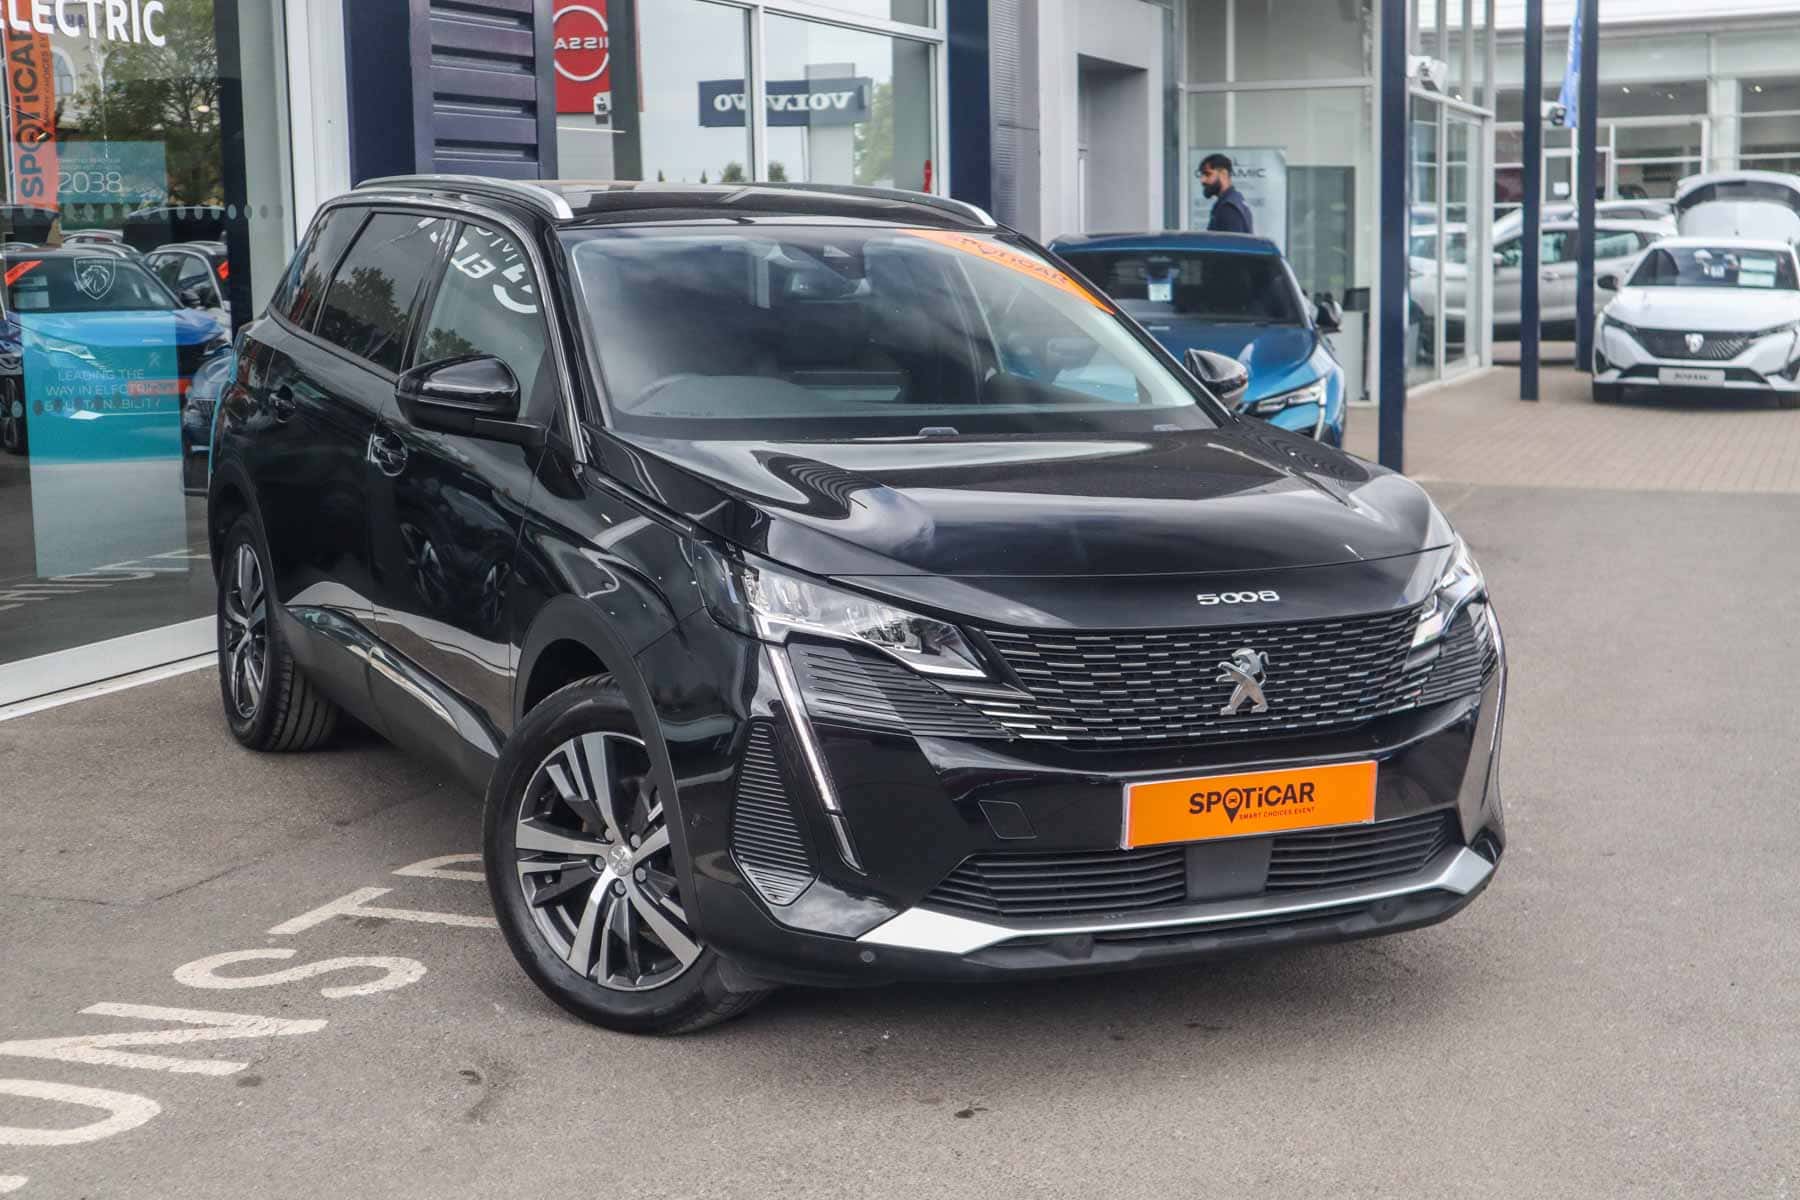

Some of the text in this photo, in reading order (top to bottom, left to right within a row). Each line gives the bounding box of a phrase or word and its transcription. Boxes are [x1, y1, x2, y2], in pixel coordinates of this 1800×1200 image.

[0, 0, 166, 47] LECTRIC
[57, 171, 121, 193] 2038
[58, 368, 144, 381] LEADING THE
[46, 386, 75, 396] WAY
[79, 385, 91, 395] IN
[1197, 590, 1280, 605] 5008
[1239, 806, 1315, 820] SMART CHOICES EVENT
